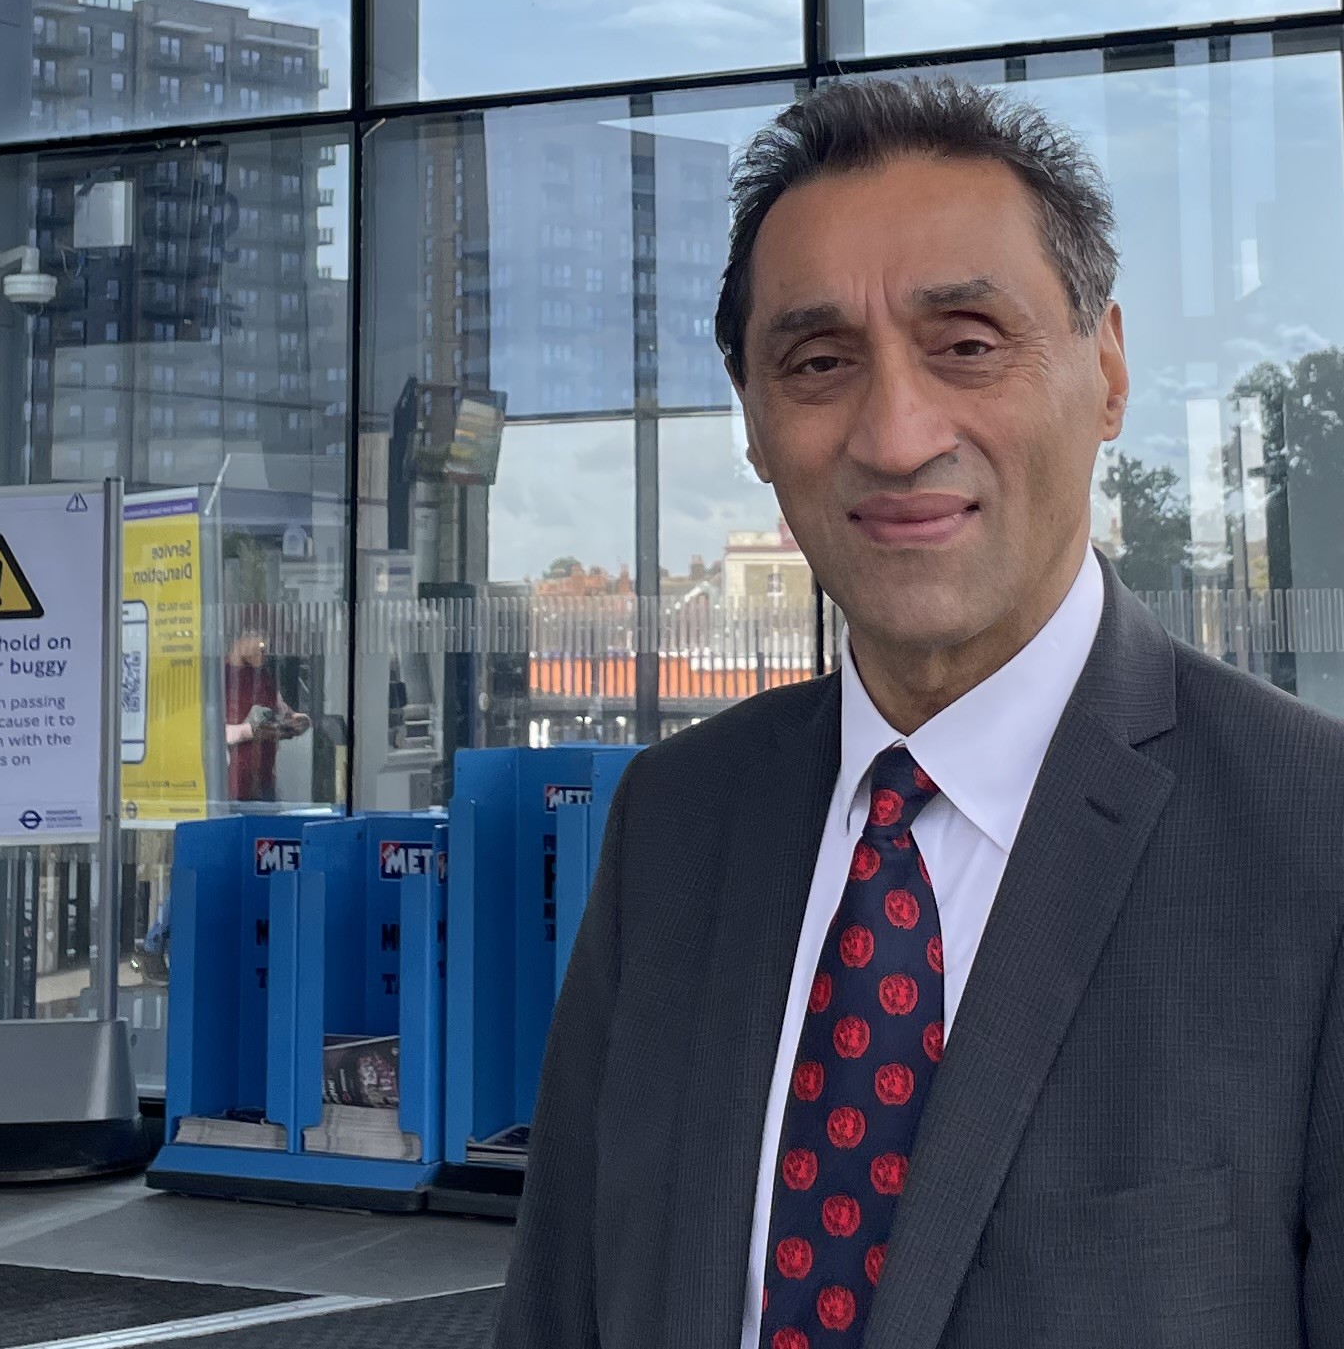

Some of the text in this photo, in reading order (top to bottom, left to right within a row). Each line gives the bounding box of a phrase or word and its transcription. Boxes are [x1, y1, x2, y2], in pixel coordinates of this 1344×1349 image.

[47, 636, 71, 650] on
[10, 658, 67, 678] buggy
[10, 696, 66, 712] passing
[44, 714, 55, 727] it
[59, 714, 75, 726] to
[8, 733, 42, 747] with
[46, 733, 72, 746] the
[11, 754, 31, 766] on
[385, 849, 433, 874] MET
